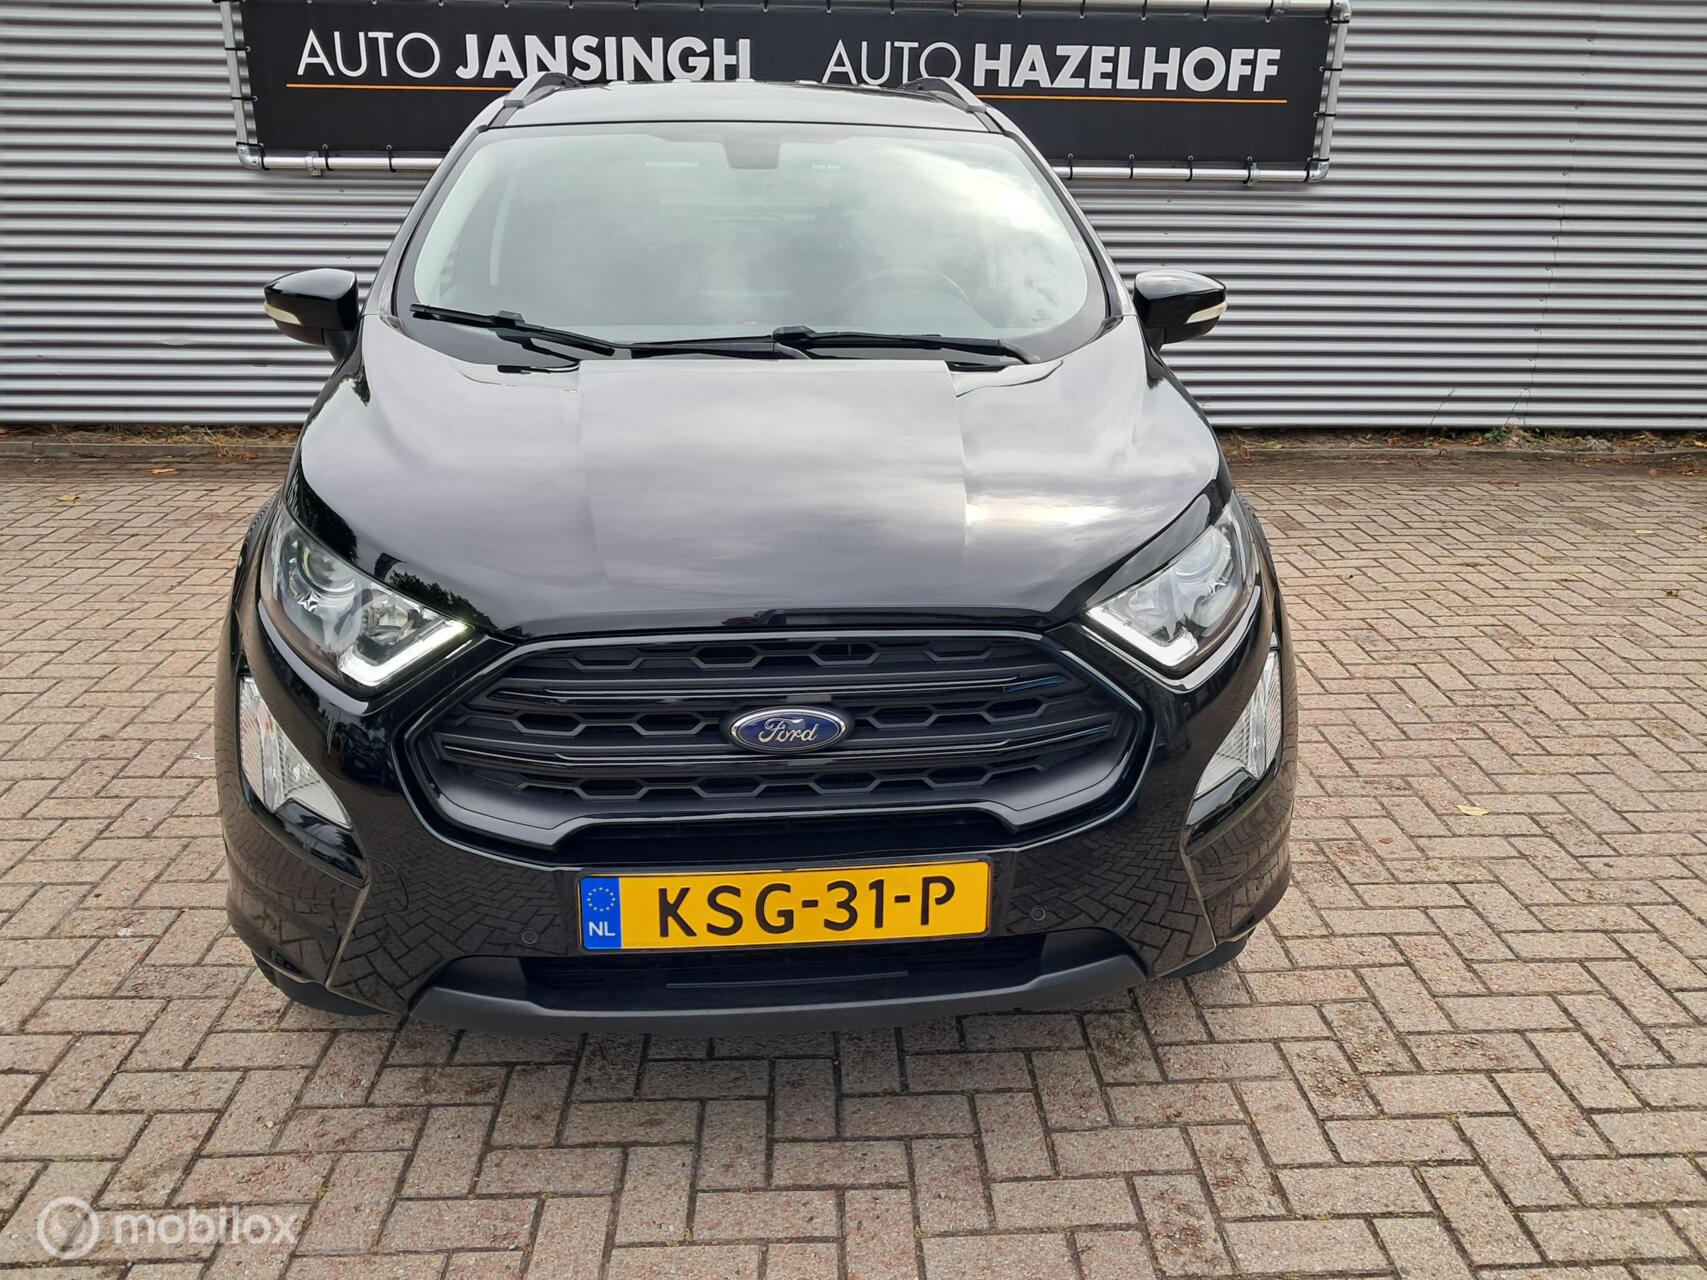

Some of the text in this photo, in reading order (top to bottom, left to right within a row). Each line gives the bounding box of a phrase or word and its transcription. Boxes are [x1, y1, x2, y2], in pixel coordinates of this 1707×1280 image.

[297, 29, 751, 81] AUTO JANSINGH
[822, 39, 1281, 92] AUTO HAZELHOFF
[758, 717, 819, 742] Ford
[589, 920, 616, 937] NL
[658, 876, 955, 938] KSG-31-P
